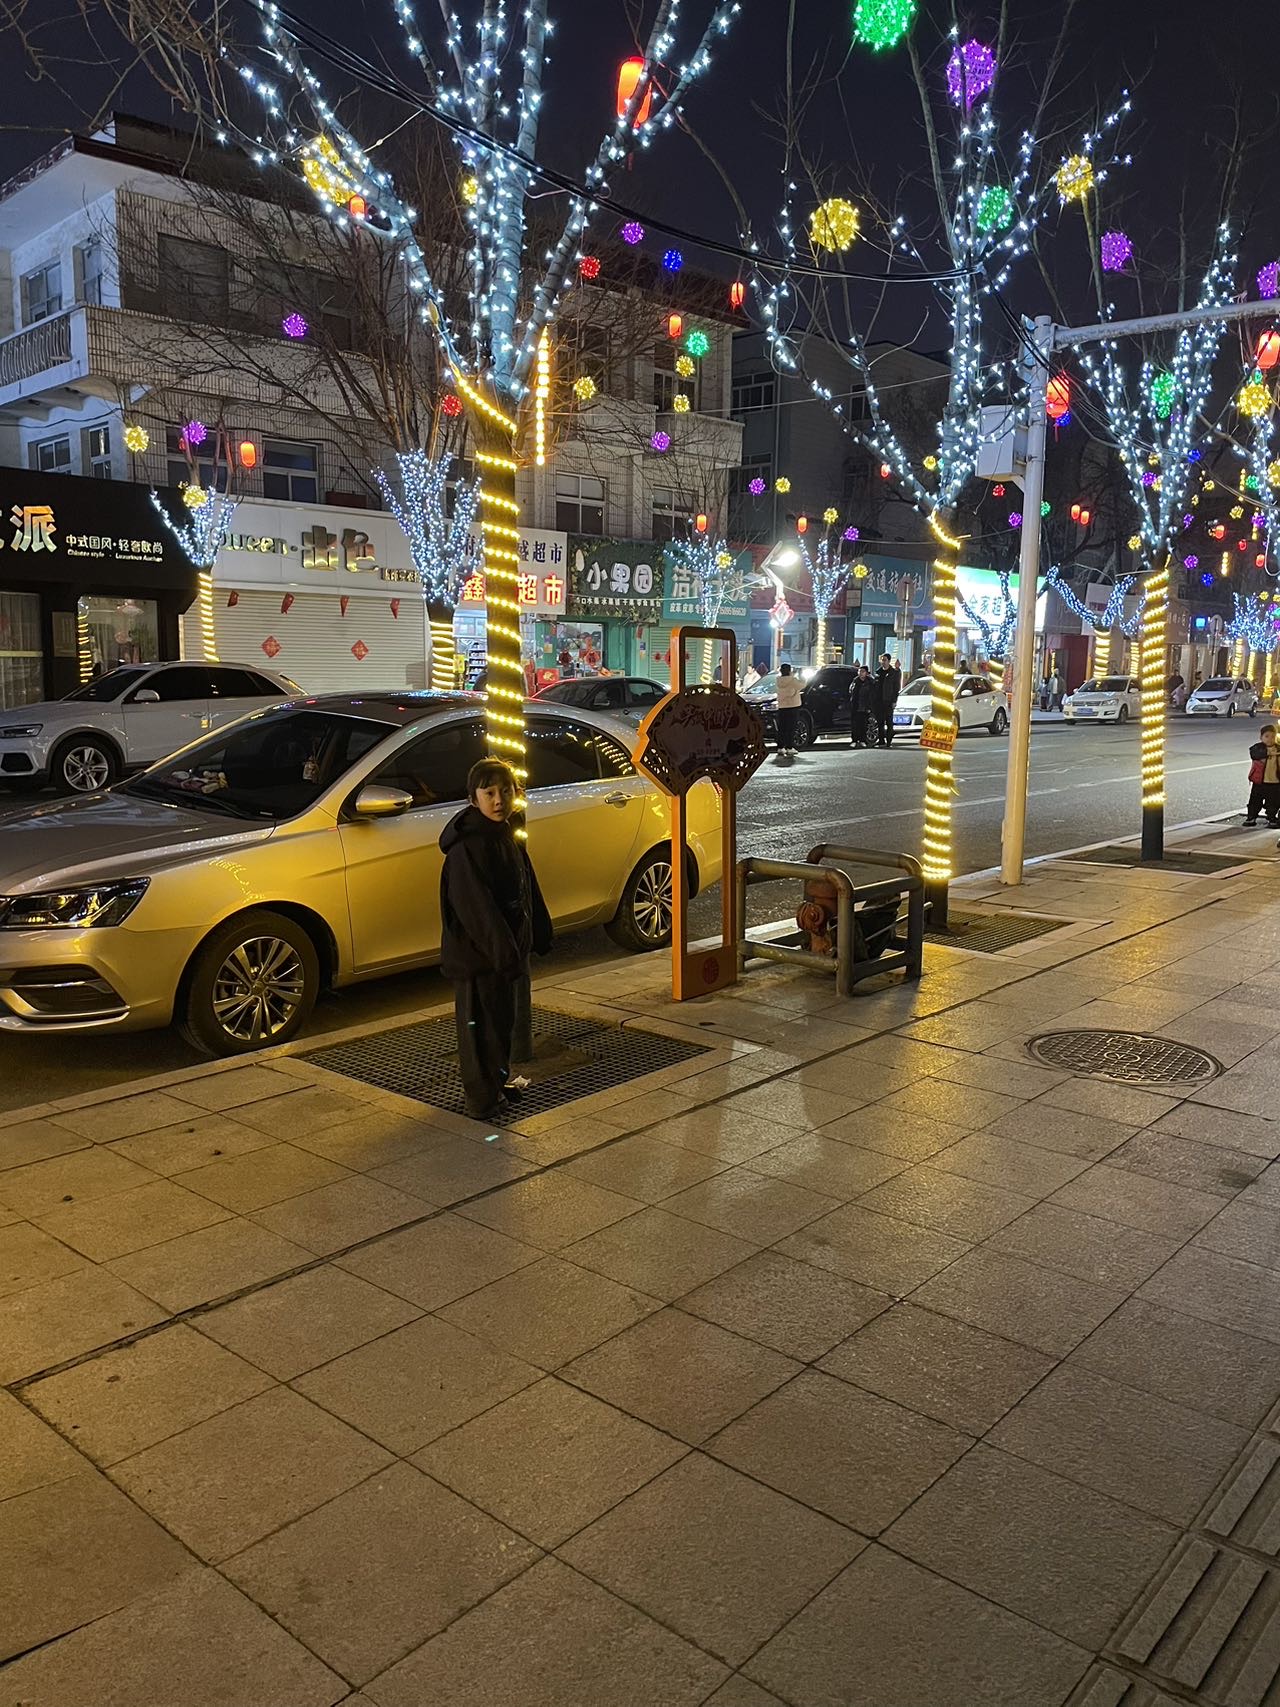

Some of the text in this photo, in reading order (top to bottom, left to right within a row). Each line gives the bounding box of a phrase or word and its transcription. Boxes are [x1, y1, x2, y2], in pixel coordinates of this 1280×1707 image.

[0, 505, 58, 553] 派
[463, 570, 564, 605] 鑫超市
[588, 563, 661, 599] 小果园
[866, 568, 923, 593] 交通旅社
[969, 594, 1002, 616] 全家超
